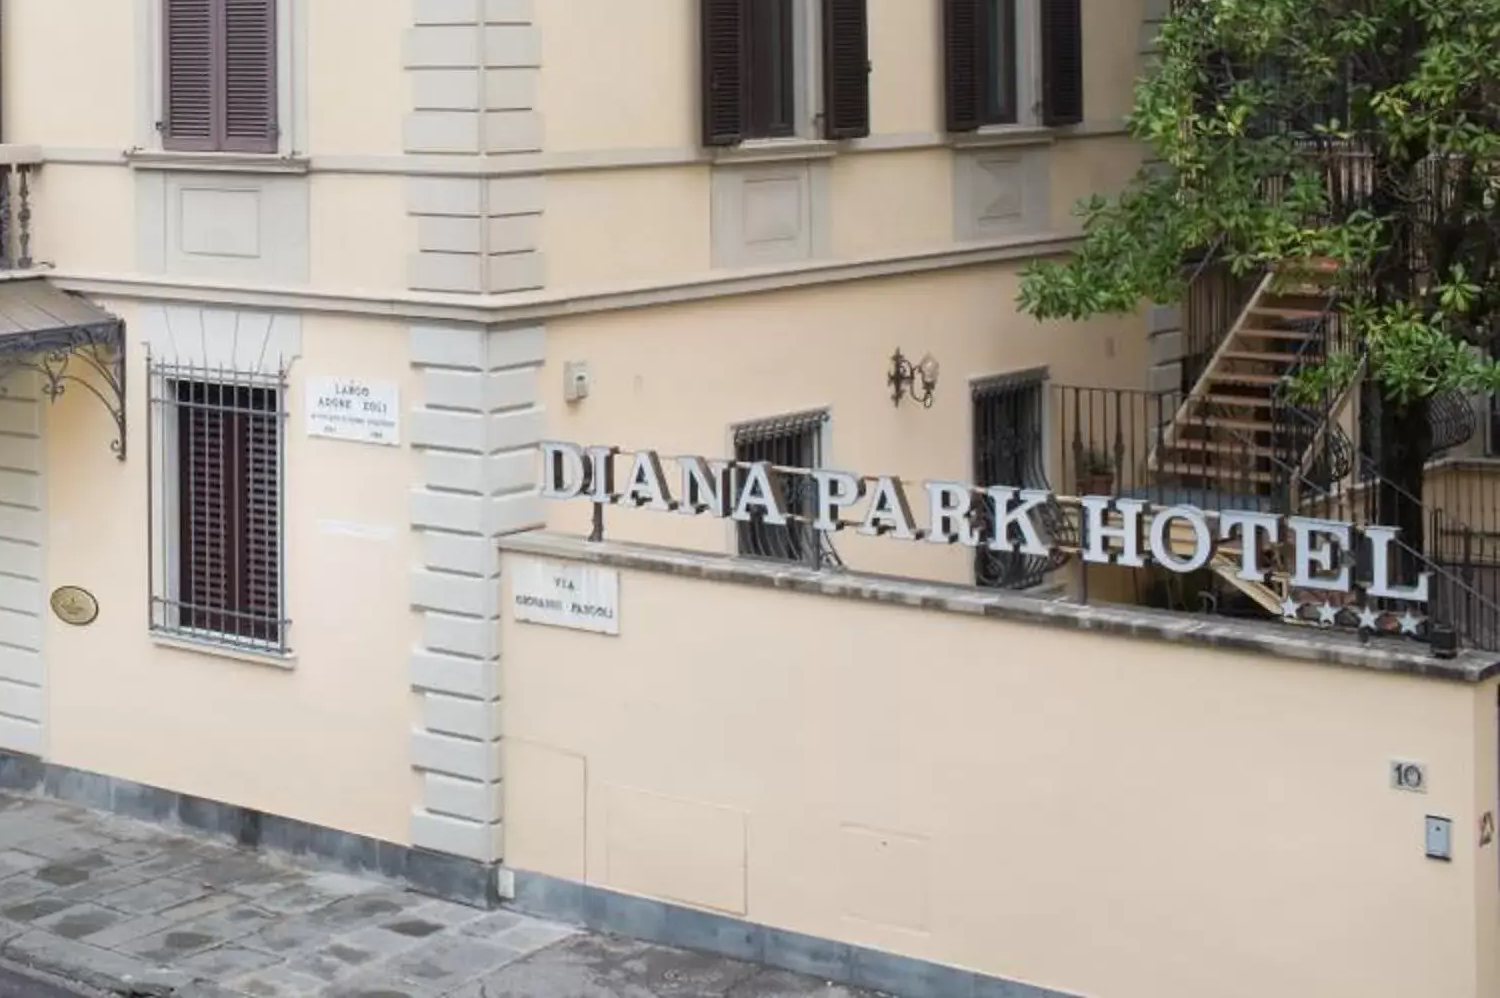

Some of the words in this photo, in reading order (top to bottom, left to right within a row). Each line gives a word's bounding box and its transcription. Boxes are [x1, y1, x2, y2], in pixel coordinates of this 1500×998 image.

[537, 440, 787, 525] DIANA
[814, 469, 1052, 556] PARK
[1080, 495, 1434, 602] HOTEL
[553, 576, 575, 591] VIA
[1394, 763, 1422, 788] 10
